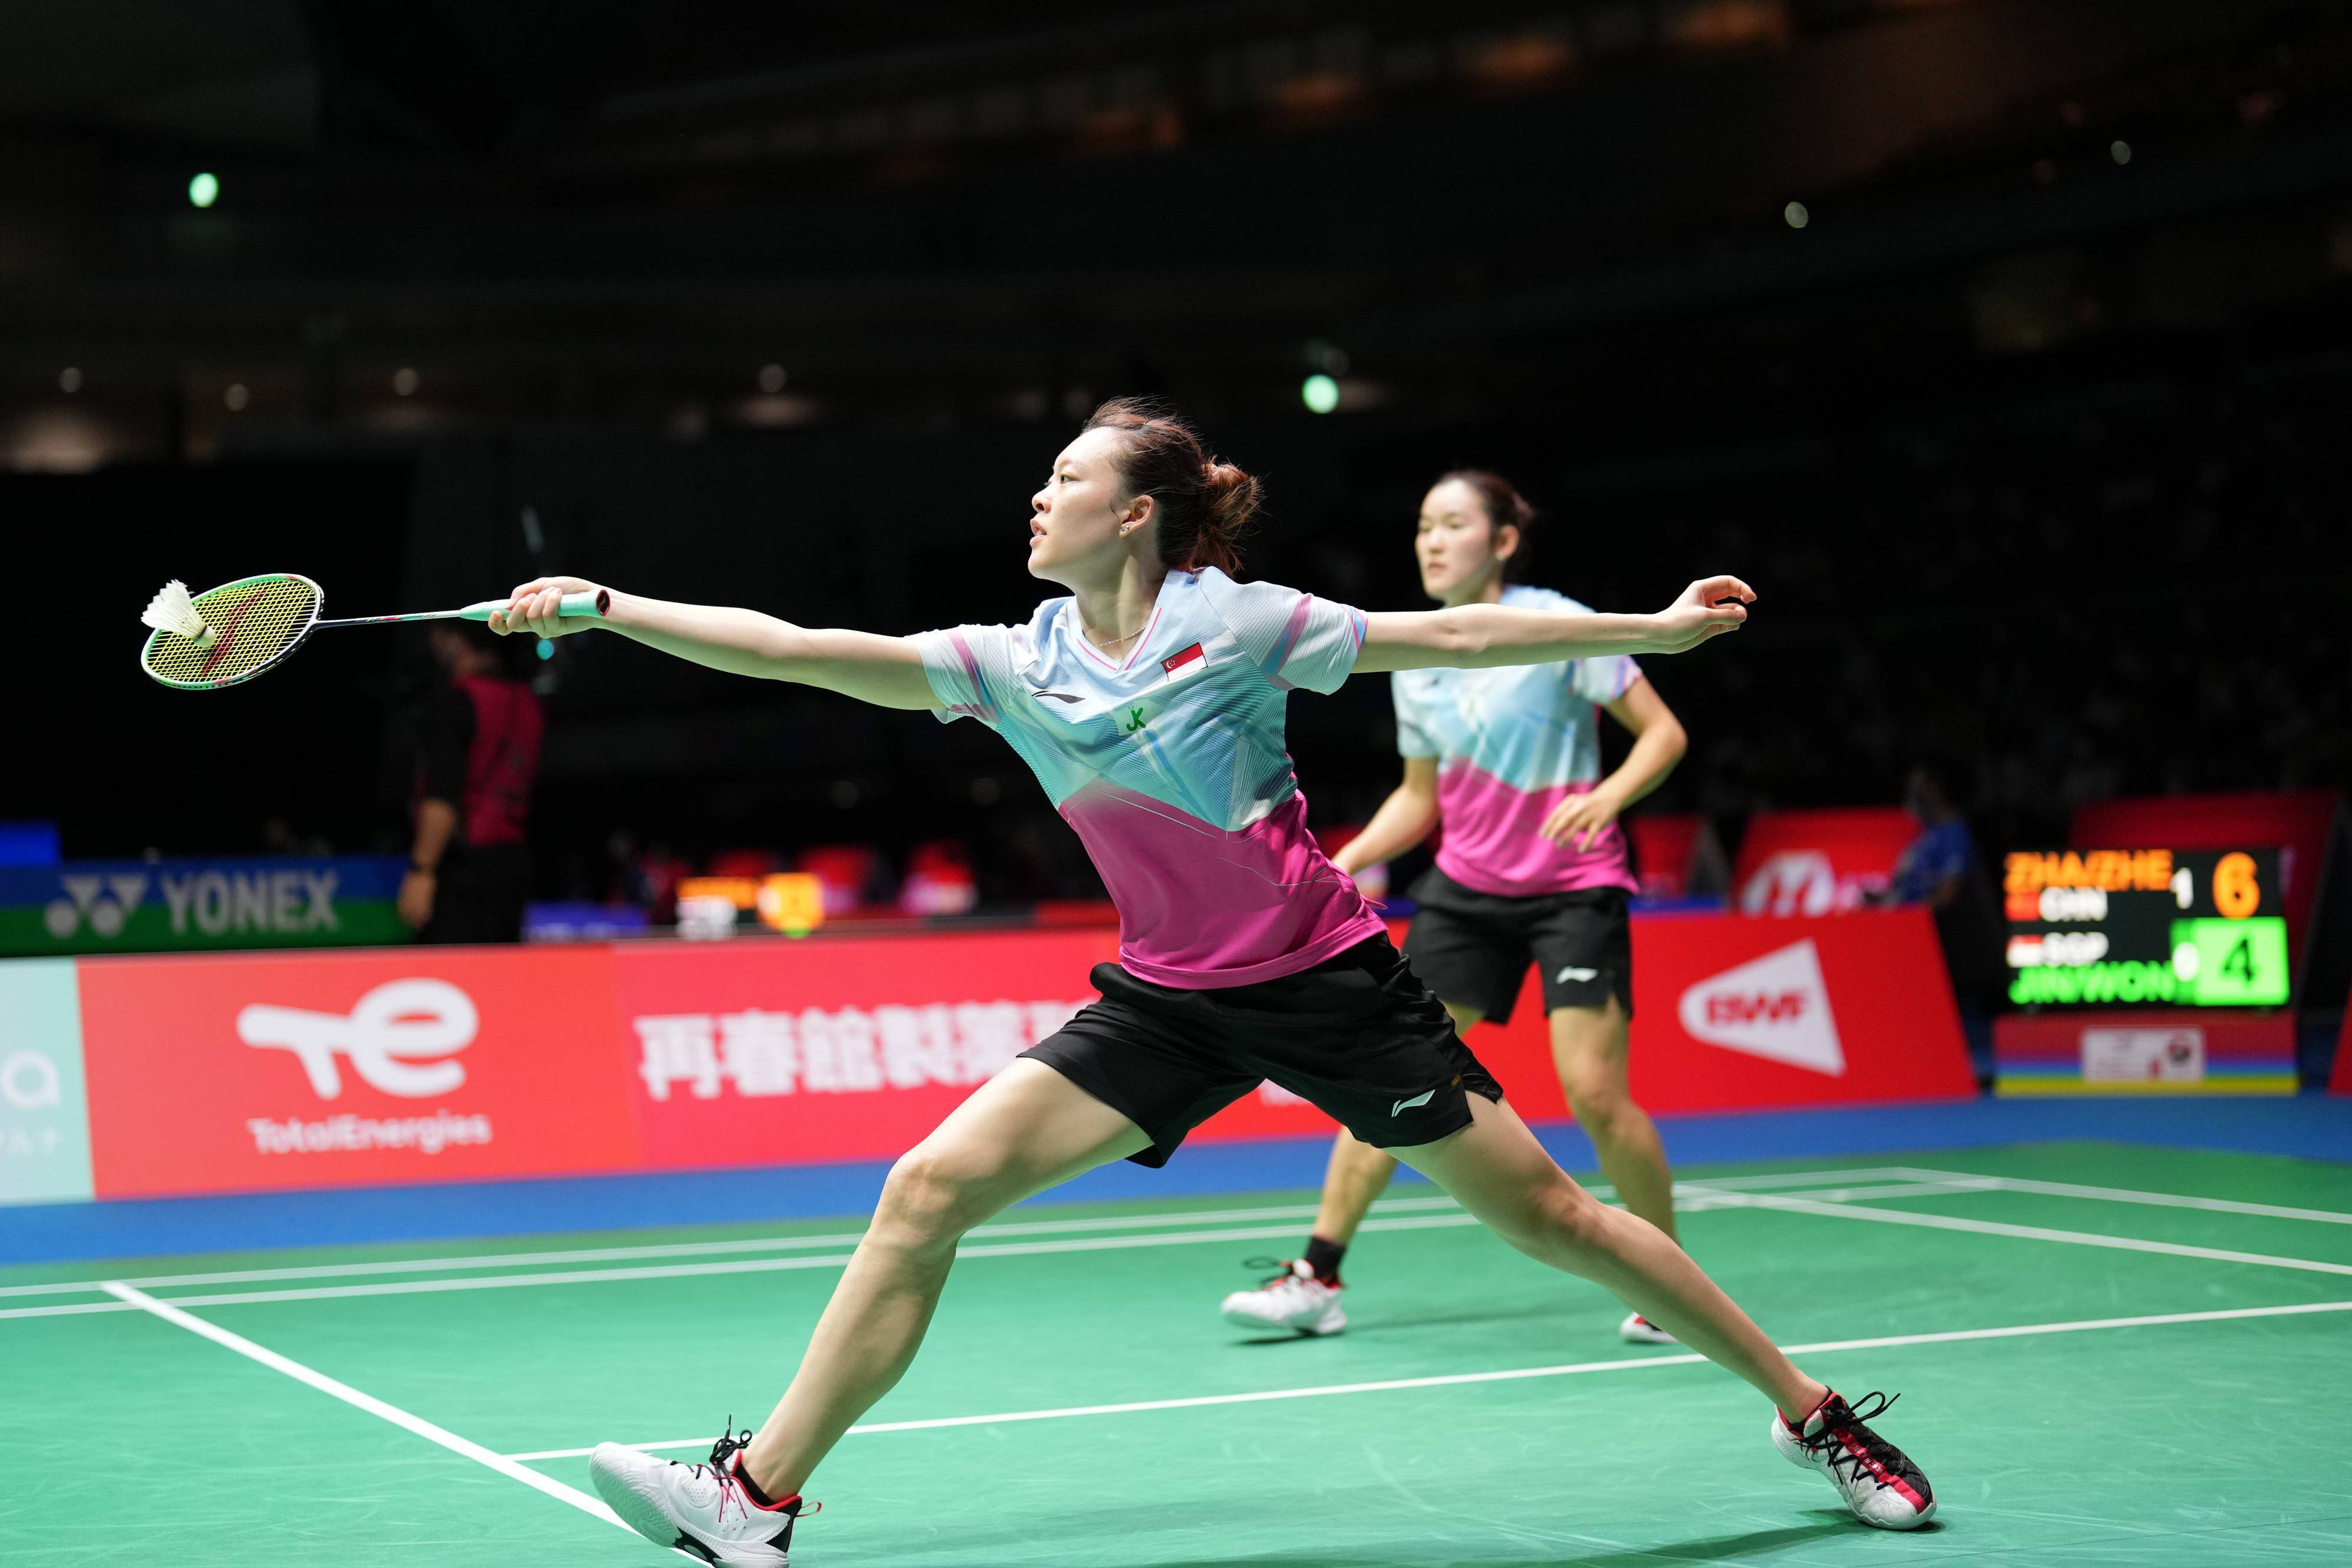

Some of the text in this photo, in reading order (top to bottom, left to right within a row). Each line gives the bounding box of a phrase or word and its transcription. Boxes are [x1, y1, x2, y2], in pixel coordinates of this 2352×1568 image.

[161, 870, 340, 935] YONEX
[2170, 867, 2193, 909] 1
[2213, 852, 2261, 920] 6
[2222, 937, 2256, 982] 4
[1706, 987, 1808, 1026] BWF
[247, 1111, 492, 1154] TotalEnergies
